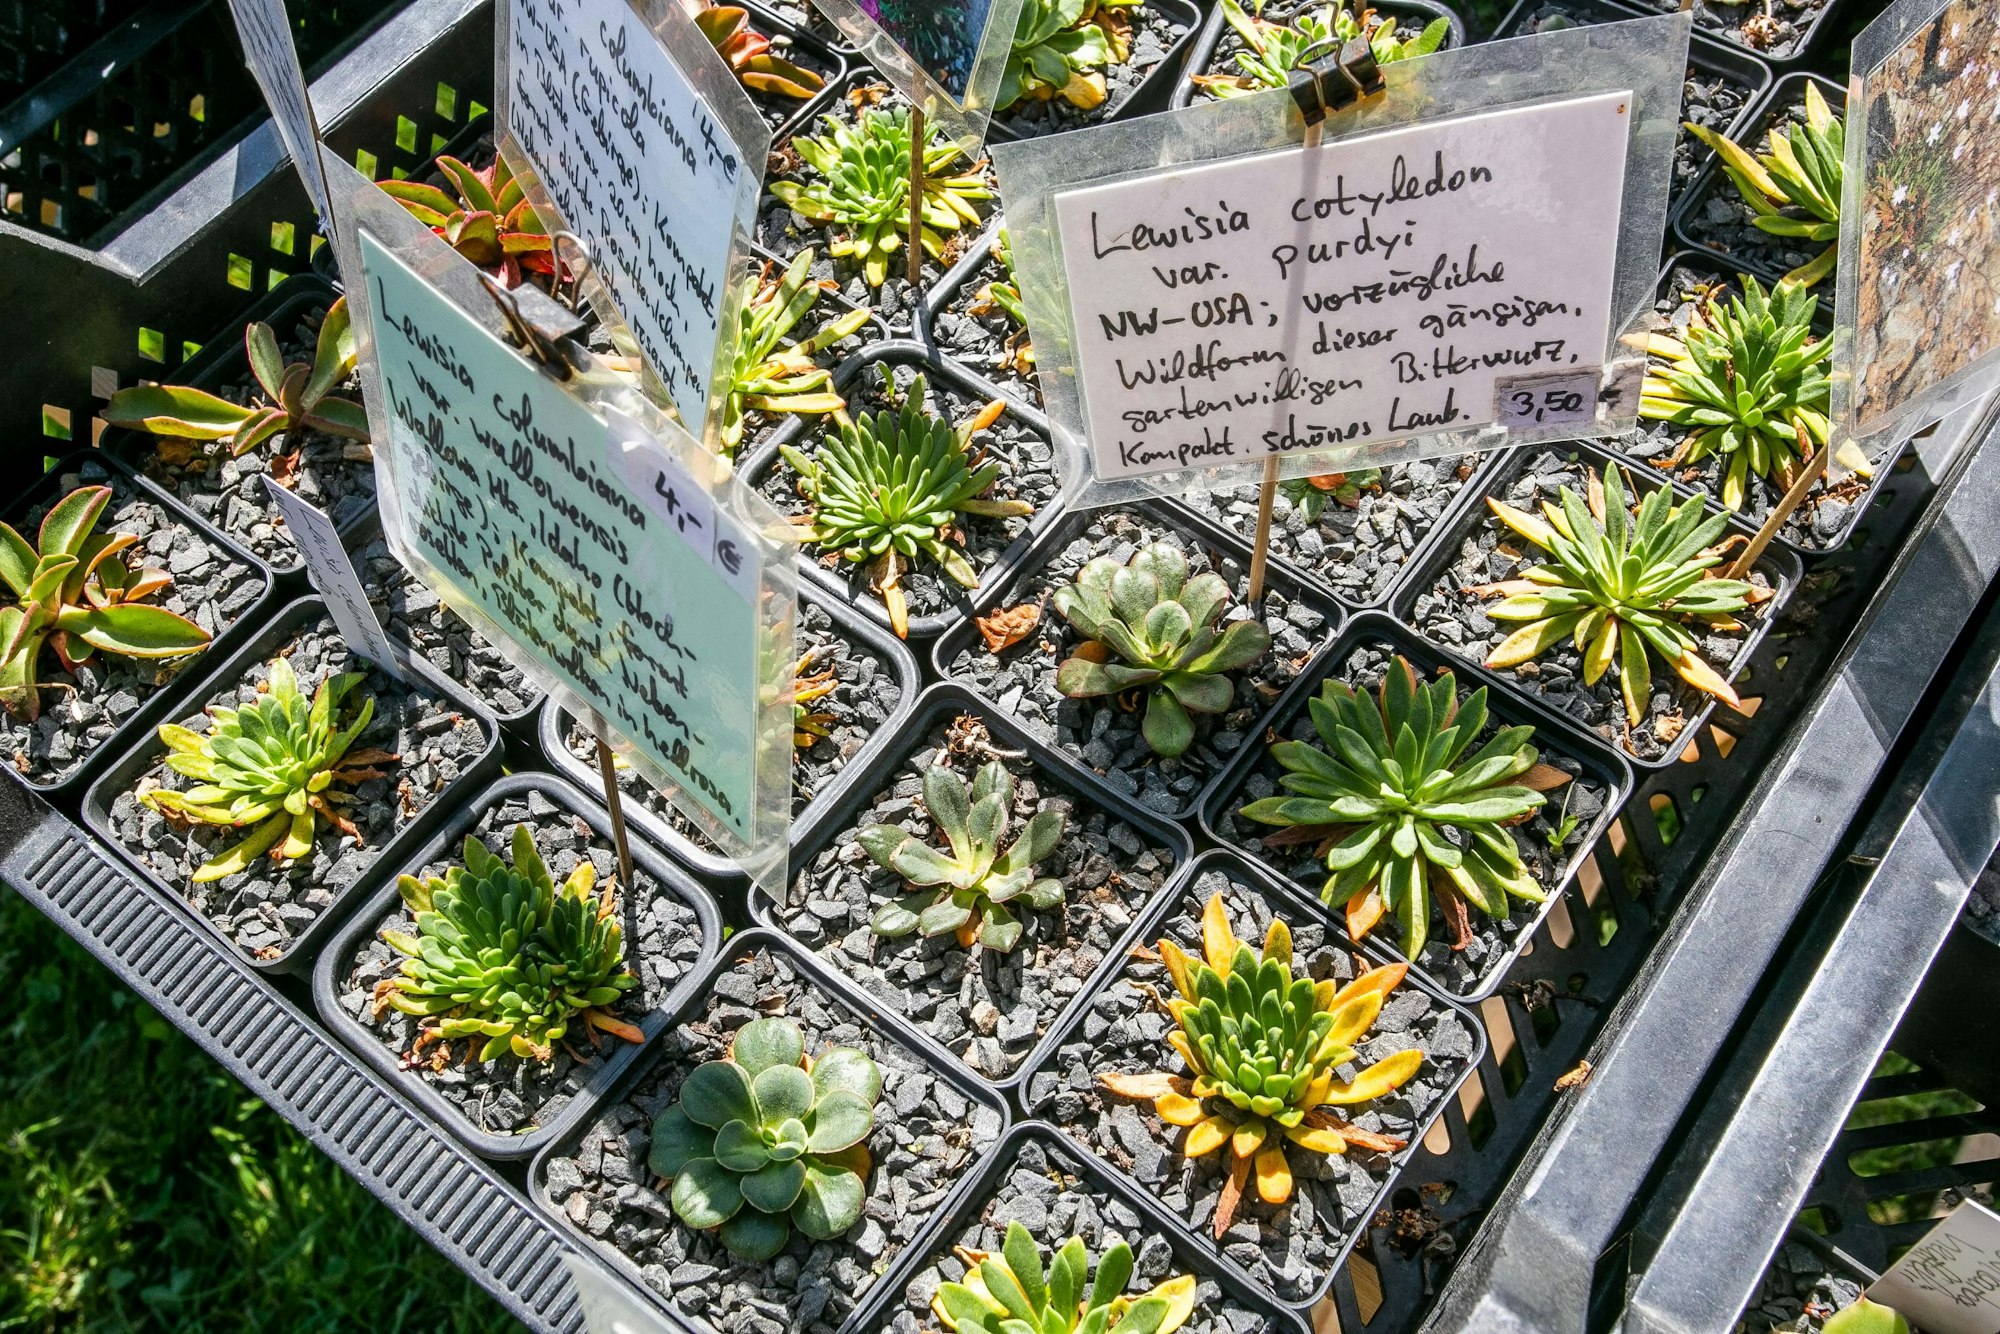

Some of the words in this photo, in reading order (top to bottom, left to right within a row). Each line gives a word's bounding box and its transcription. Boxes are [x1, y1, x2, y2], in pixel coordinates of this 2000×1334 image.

[516, 17, 528, 65] in
[580, 37, 647, 157] rupicola
[600, 20, 696, 176] columbiana
[1091, 200, 1250, 260] Lewisia
[1291, 150, 1493, 224] cotyledon
[1152, 264, 1229, 290] var.
[1272, 220, 1417, 281] purdyi
[1116, 340, 1287, 391] Wildform
[1311, 320, 1398, 356] dieser
[377, 275, 474, 394] Lewisia
[492, 392, 645, 530] columbiana
[1120, 368, 1363, 432] gartenwilligen
[1262, 414, 1373, 453] schönes
[1511, 390, 1584, 423] 3,50
[387, 376, 480, 487] Wallowa
[539, 508, 602, 588] Idaho
[407, 360, 460, 425] var.
[470, 418, 628, 564] wallowensis
[475, 532, 546, 612] Polster
[617, 693, 638, 732] in
